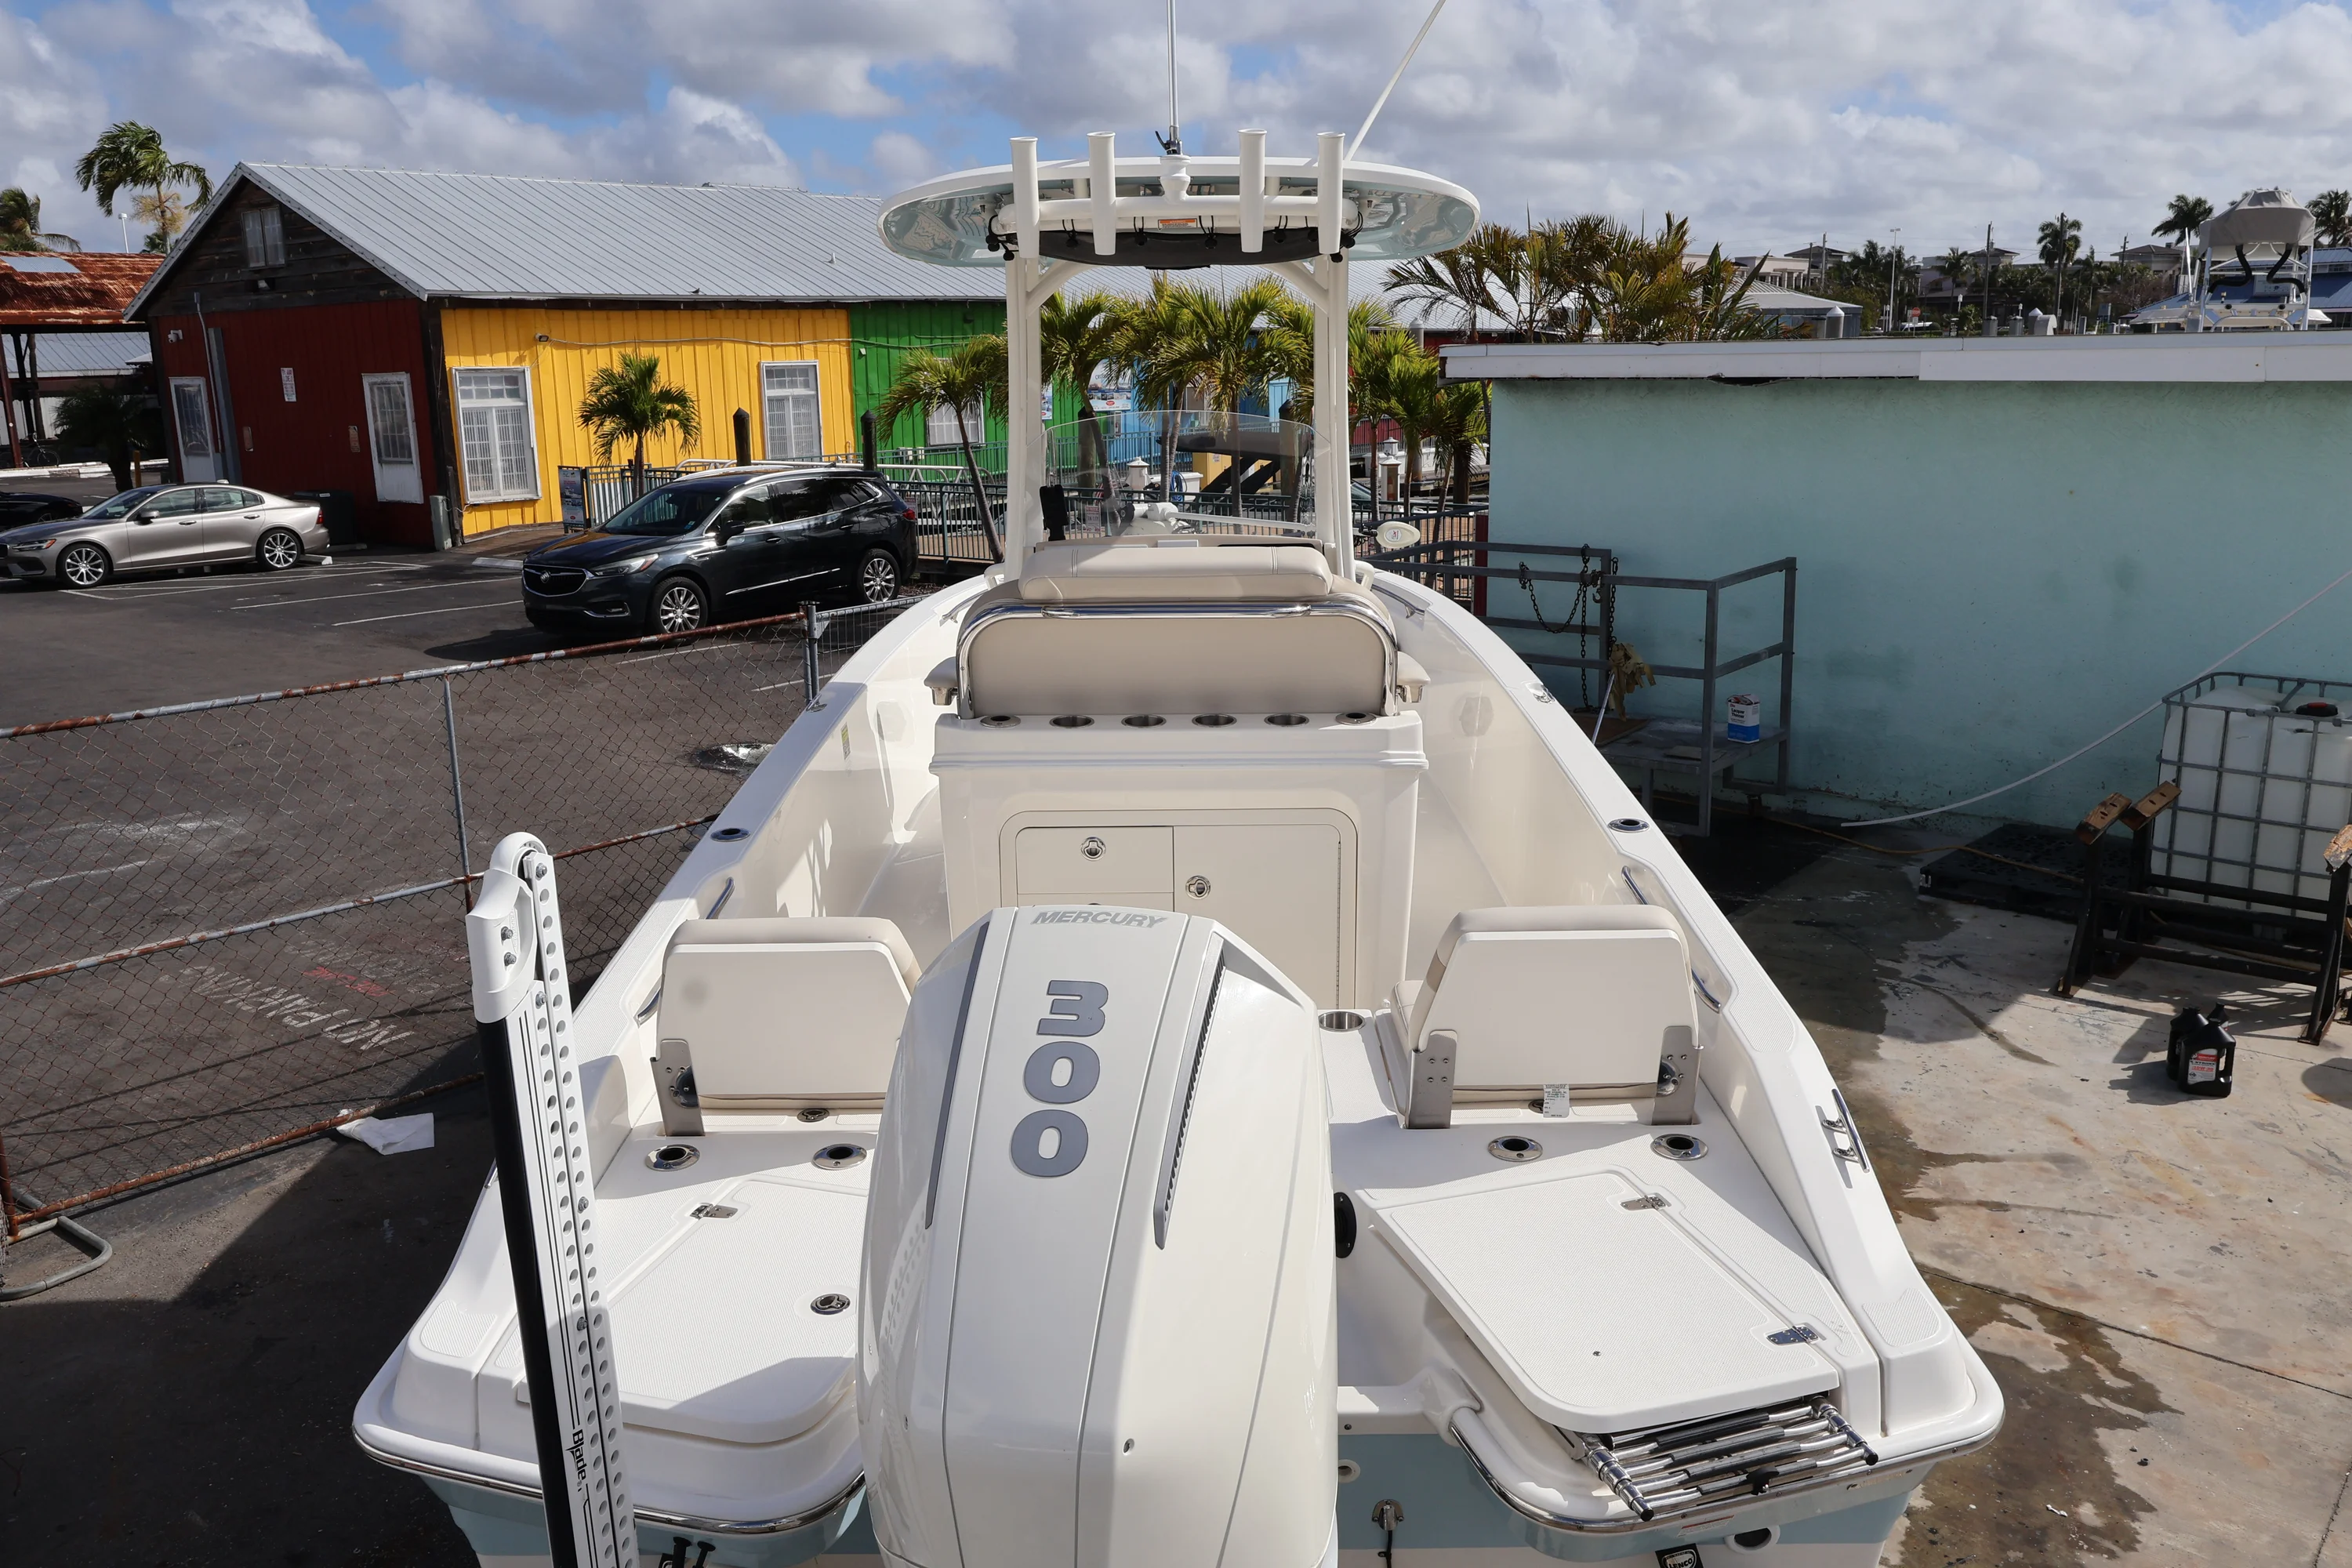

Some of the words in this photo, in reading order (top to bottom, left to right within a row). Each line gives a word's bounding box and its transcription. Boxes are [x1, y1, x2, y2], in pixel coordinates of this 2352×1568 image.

[1030, 910, 1169, 928] MERCURY
[322, 1018, 415, 1051] NO
[1010, 980, 1109, 1178] 300
[565, 1428, 587, 1481] Blade
